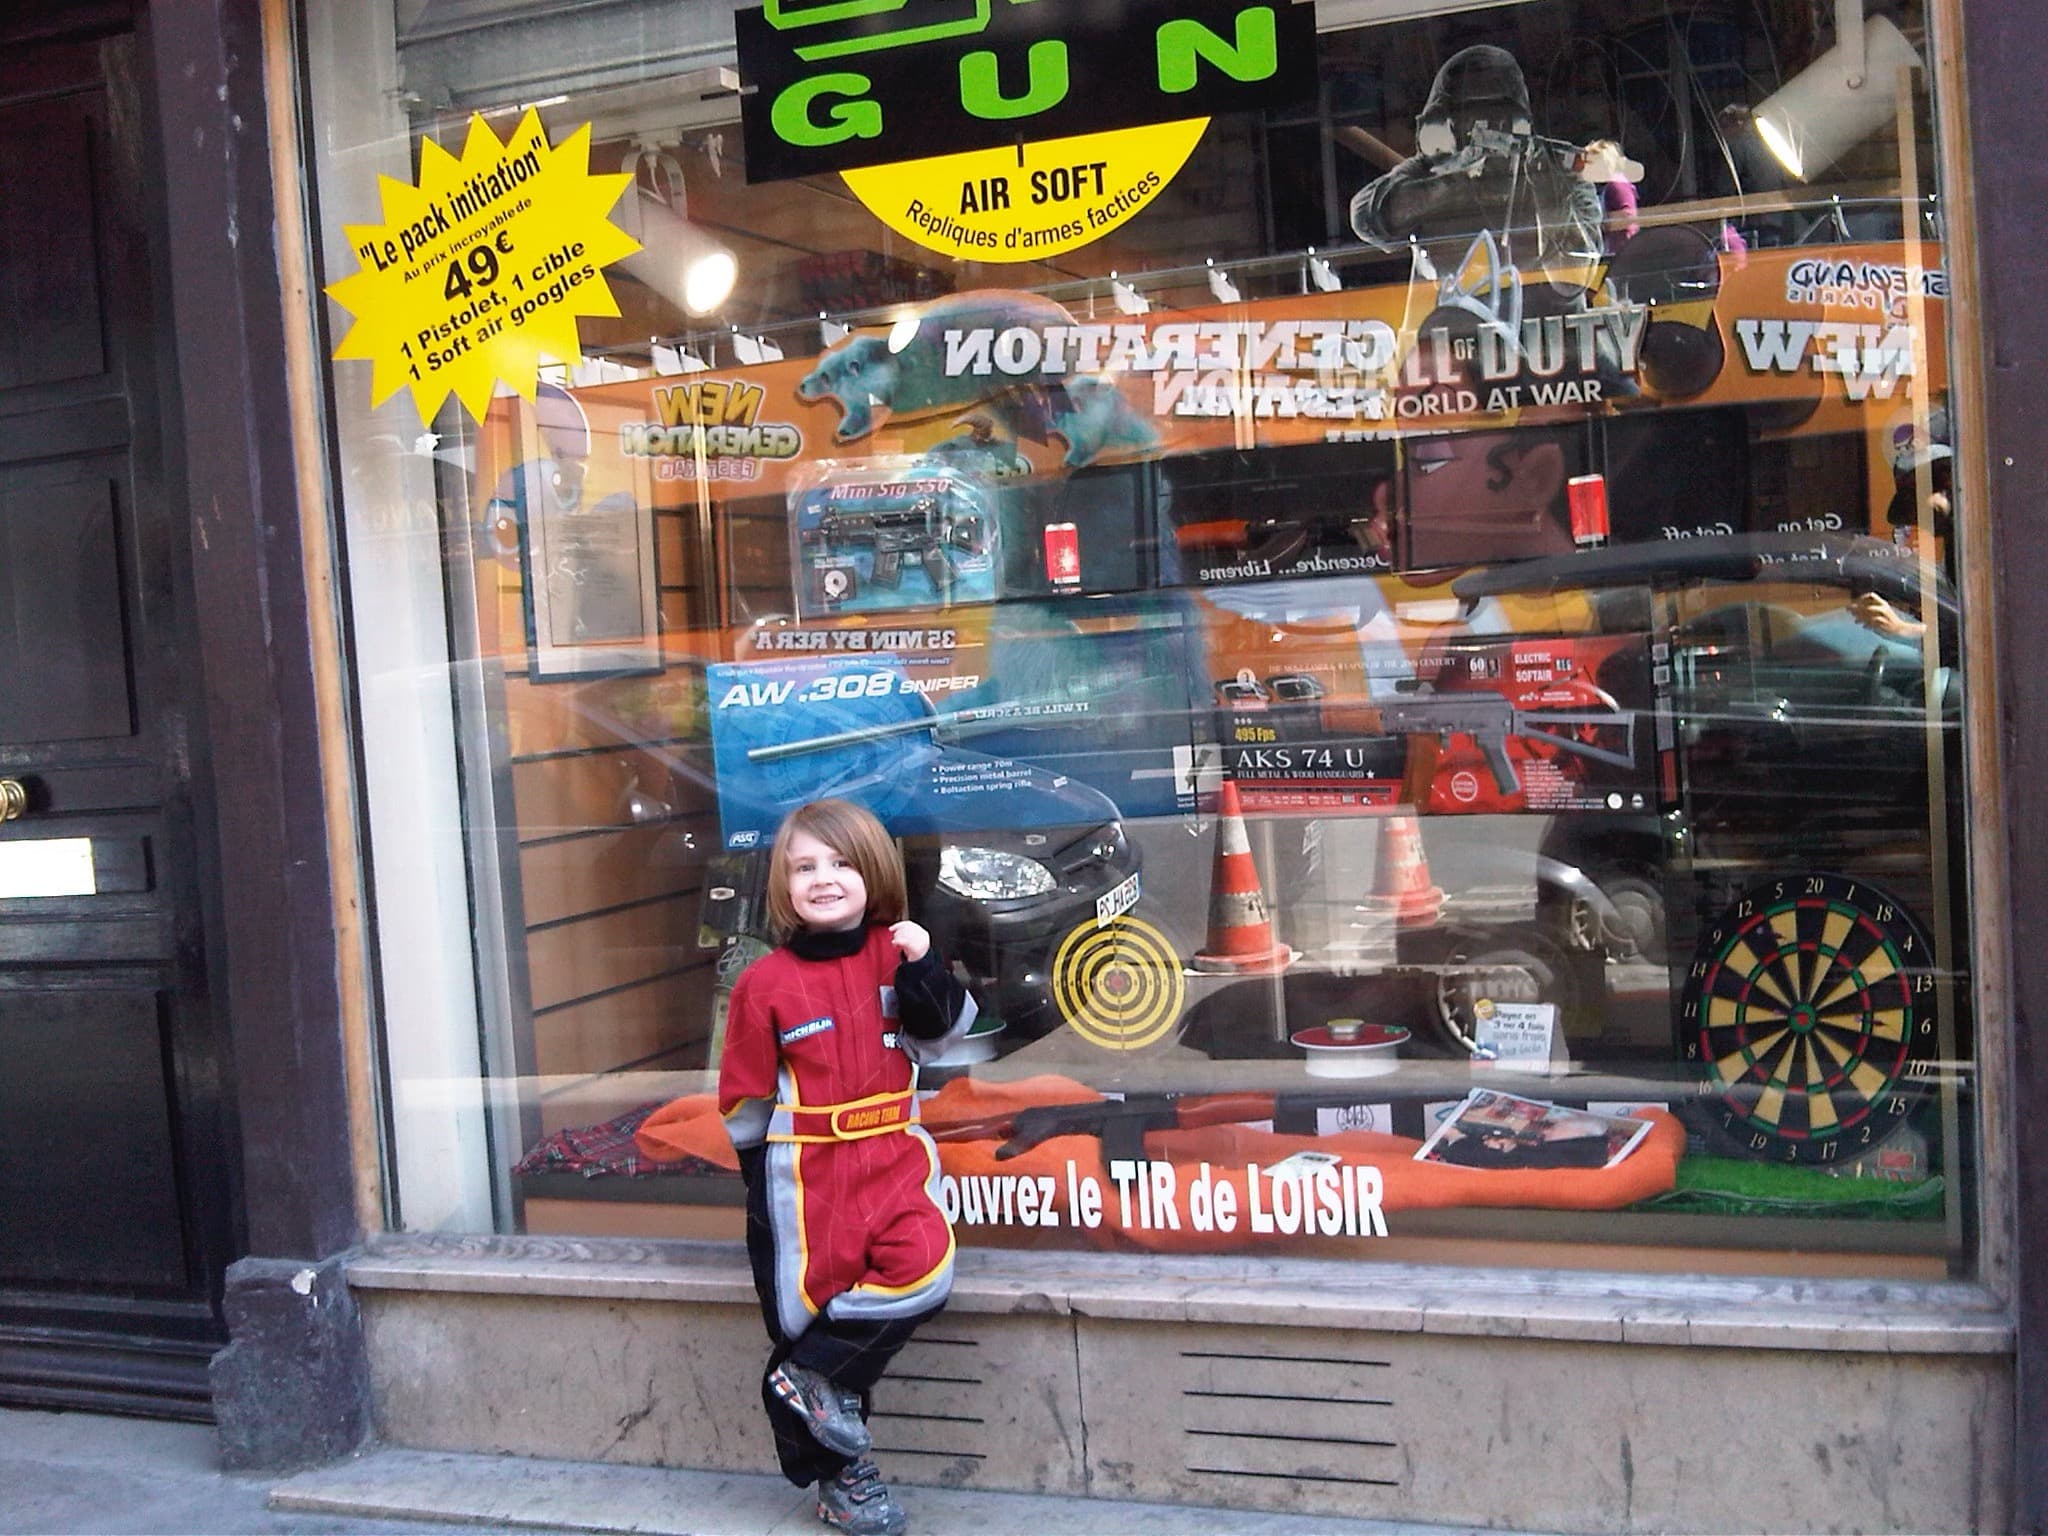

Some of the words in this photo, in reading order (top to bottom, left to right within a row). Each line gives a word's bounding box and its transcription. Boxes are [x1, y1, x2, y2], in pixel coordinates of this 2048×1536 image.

[771, 6, 1277, 147] GUN
[960, 177, 1009, 215] AIR
[1031, 162, 1107, 205] SOFT
[360, 241, 399, 272] "Le
[400, 203, 450, 261] pack
[447, 136, 543, 222] initiation"
[905, 199, 998, 250] Répliques
[1004, 220, 1083, 250] d'armes
[1086, 169, 1161, 230] factices
[403, 266, 420, 283] Au
[423, 252, 447, 275] prix
[450, 208, 516, 255] incroyable
[444, 230, 514, 302] 49€
[401, 342, 412, 359] 1
[418, 288, 508, 351] Pistolet,
[512, 274, 523, 291] 1
[533, 240, 585, 282] cible
[409, 364, 421, 381] 1
[428, 339, 472, 371] Soft
[477, 317, 505, 343] air
[510, 264, 596, 327] googles
[1454, 338, 1475, 361] OF
[1479, 309, 1652, 380] DUTY
[1485, 386, 1522, 414] AT
[1529, 380, 1602, 406] WAR
[827, 481, 873, 501] Mini
[876, 481, 908, 499] Sig
[1469, 657, 1485, 671] 60
[1514, 652, 1551, 665] ELECTRIC
[1515, 669, 1552, 683] SOFTAIR
[719, 680, 795, 709] AW
[799, 673, 895, 702] .308
[899, 675, 980, 694] SNIPER
[1235, 727, 1256, 742] 495
[1256, 727, 1276, 744] Fps
[1237, 749, 1292, 769] AKS
[1301, 749, 1333, 768] 74
[1344, 748, 1364, 768] U
[939, 763, 966, 773] Power
[939, 773, 978, 784] Precision
[980, 771, 1004, 780] metal
[1006, 767, 1033, 778] barrel
[1775, 884, 1784, 898] 5
[1805, 878, 1824, 894] 20
[1847, 885, 1855, 900] 1
[1738, 901, 1753, 918] 12
[1875, 904, 1893, 922] 18
[1713, 930, 1722, 945] 9
[1904, 935, 1913, 953] 4
[1691, 962, 1706, 977] 14
[1915, 976, 1933, 992] 13
[1684, 1003, 1697, 1017] 11
[1921, 1019, 1931, 1034] 6
[1688, 1043, 1696, 1058] 8
[1909, 1059, 1927, 1077] 10
[1889, 1097, 1905, 1116] 15
[1750, 1133, 1767, 1150] 19
[1861, 1126, 1871, 1144] 2
[1787, 1146, 1797, 1161] 3
[1822, 1143, 1837, 1160] 17
[1067, 1160, 1102, 1229] le
[1110, 1161, 1181, 1231] TIR
[1190, 1162, 1238, 1233] de
[1248, 1162, 1389, 1238] LOISIR
